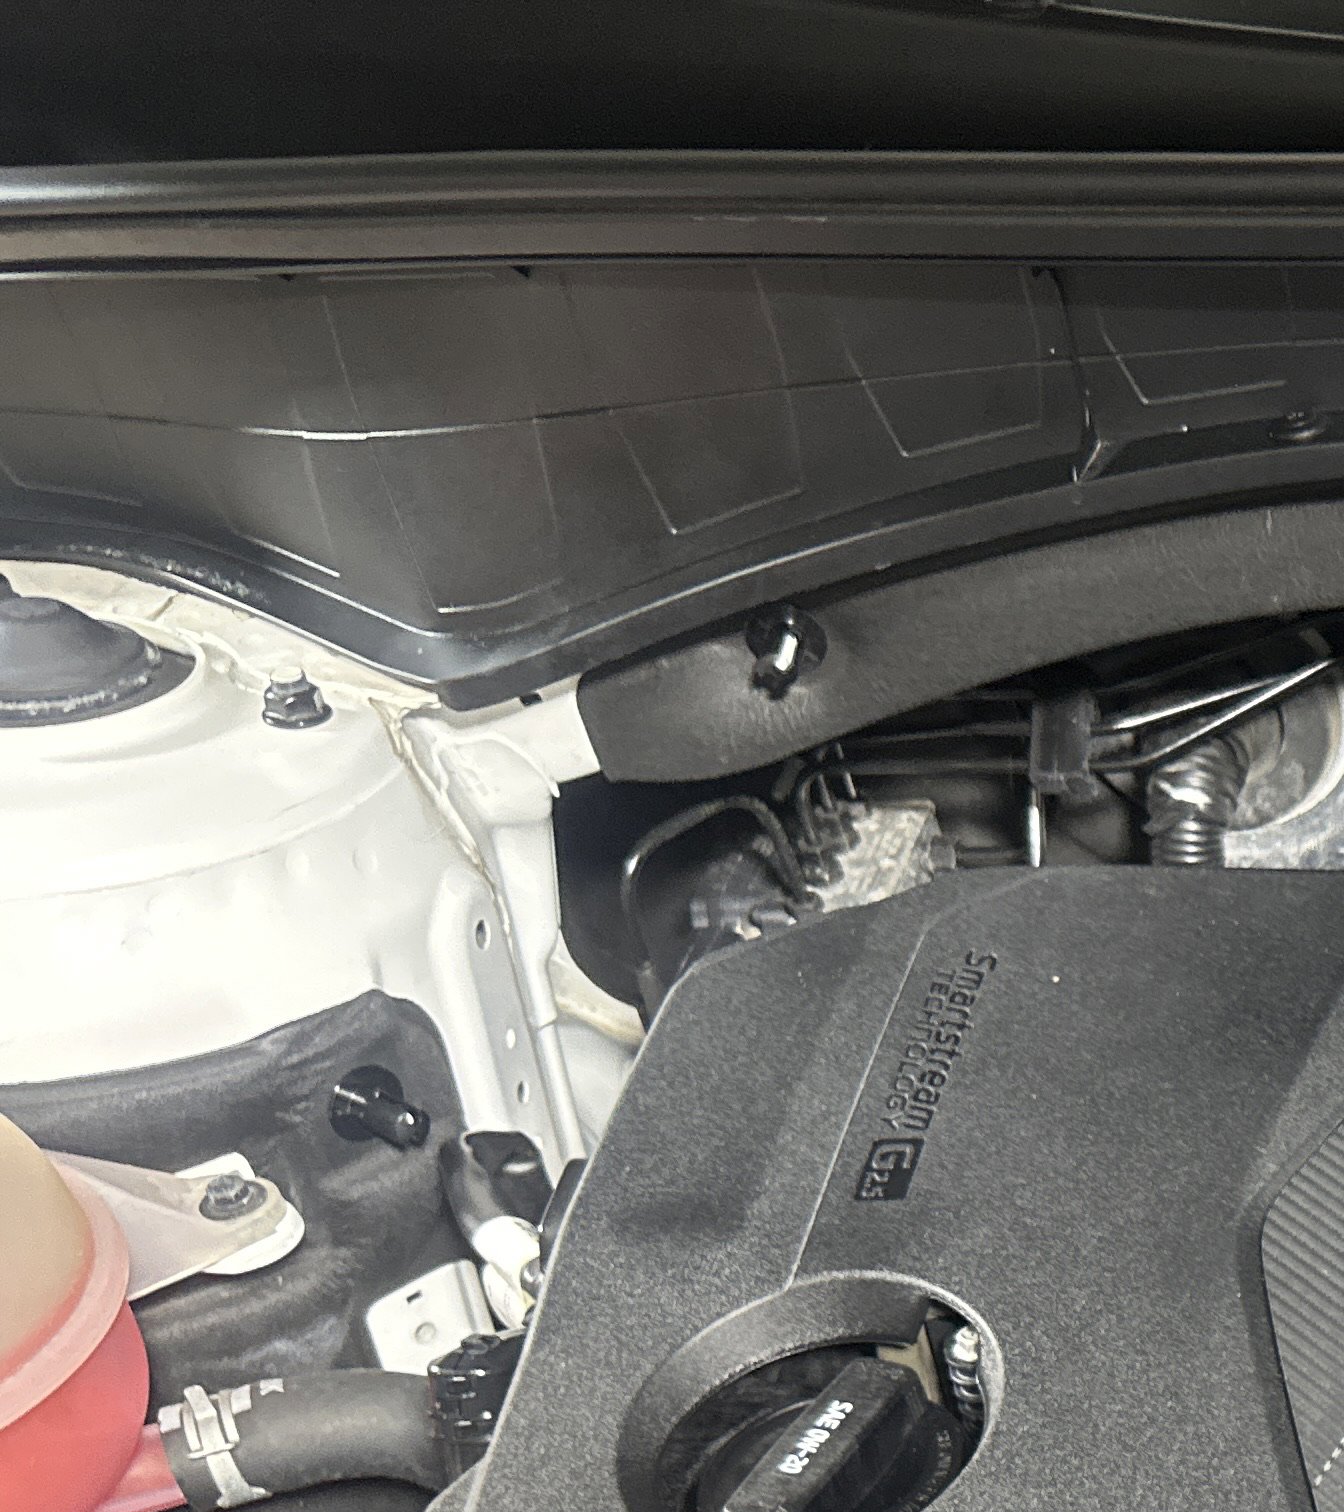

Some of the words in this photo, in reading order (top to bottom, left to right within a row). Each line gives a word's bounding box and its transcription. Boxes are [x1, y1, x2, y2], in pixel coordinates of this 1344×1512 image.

[902, 947, 999, 1132] Smartstream
[815, 1400, 854, 1430] SAE
[776, 1428, 831, 1474] 0W-20
